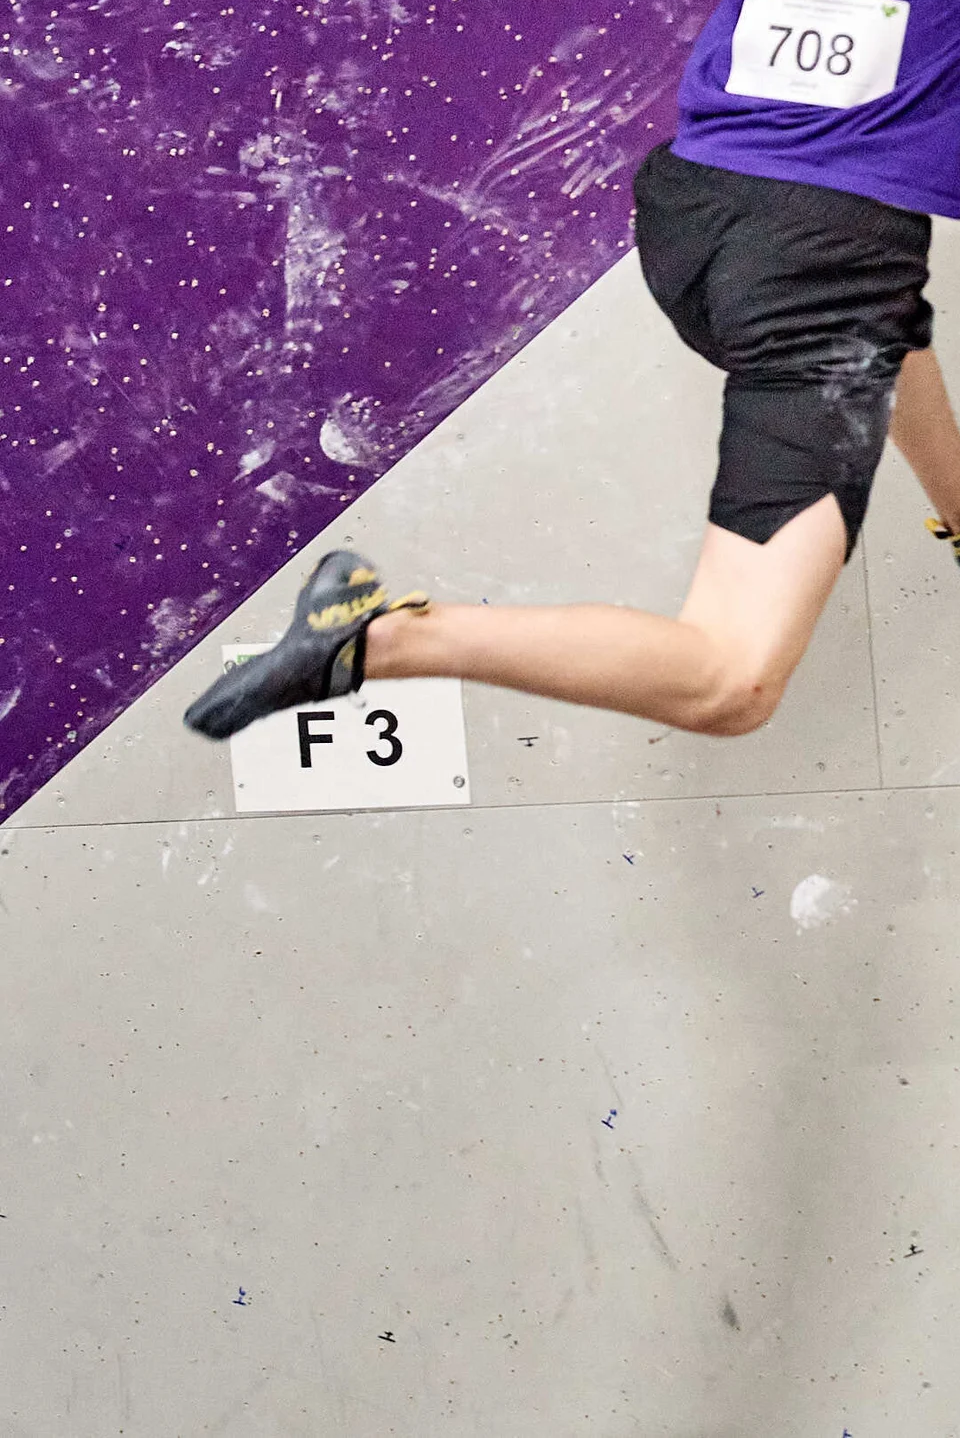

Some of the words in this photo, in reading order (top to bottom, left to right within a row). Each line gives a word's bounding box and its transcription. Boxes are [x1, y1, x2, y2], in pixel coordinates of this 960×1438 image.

[768, 25, 854, 76] 708
[296, 711, 335, 768] F
[364, 709, 403, 766] 3
